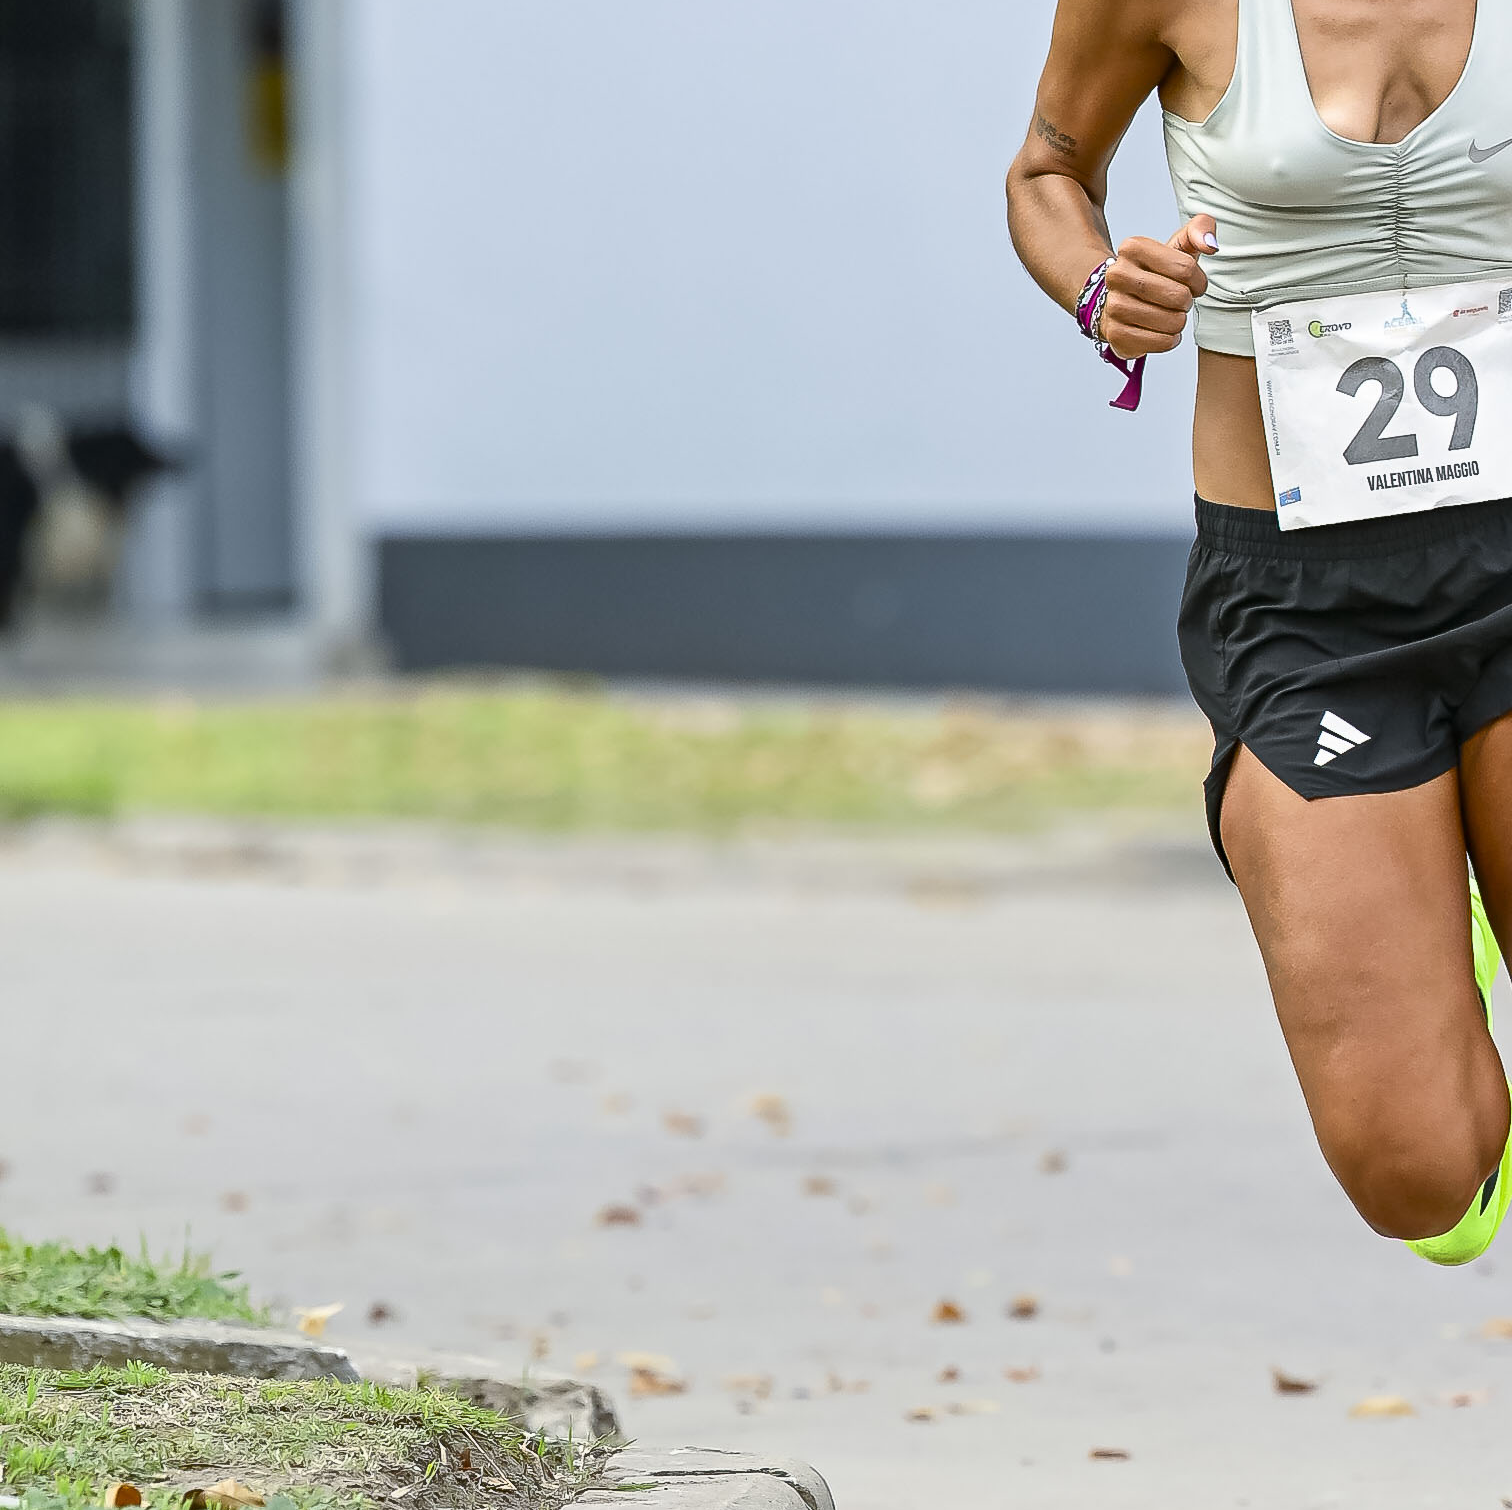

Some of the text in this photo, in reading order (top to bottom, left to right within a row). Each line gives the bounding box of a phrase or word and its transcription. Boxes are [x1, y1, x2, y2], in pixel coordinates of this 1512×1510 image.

[1336, 346, 1478, 465] 29
[1367, 460, 1480, 492] VALENTINA MAGGIO
